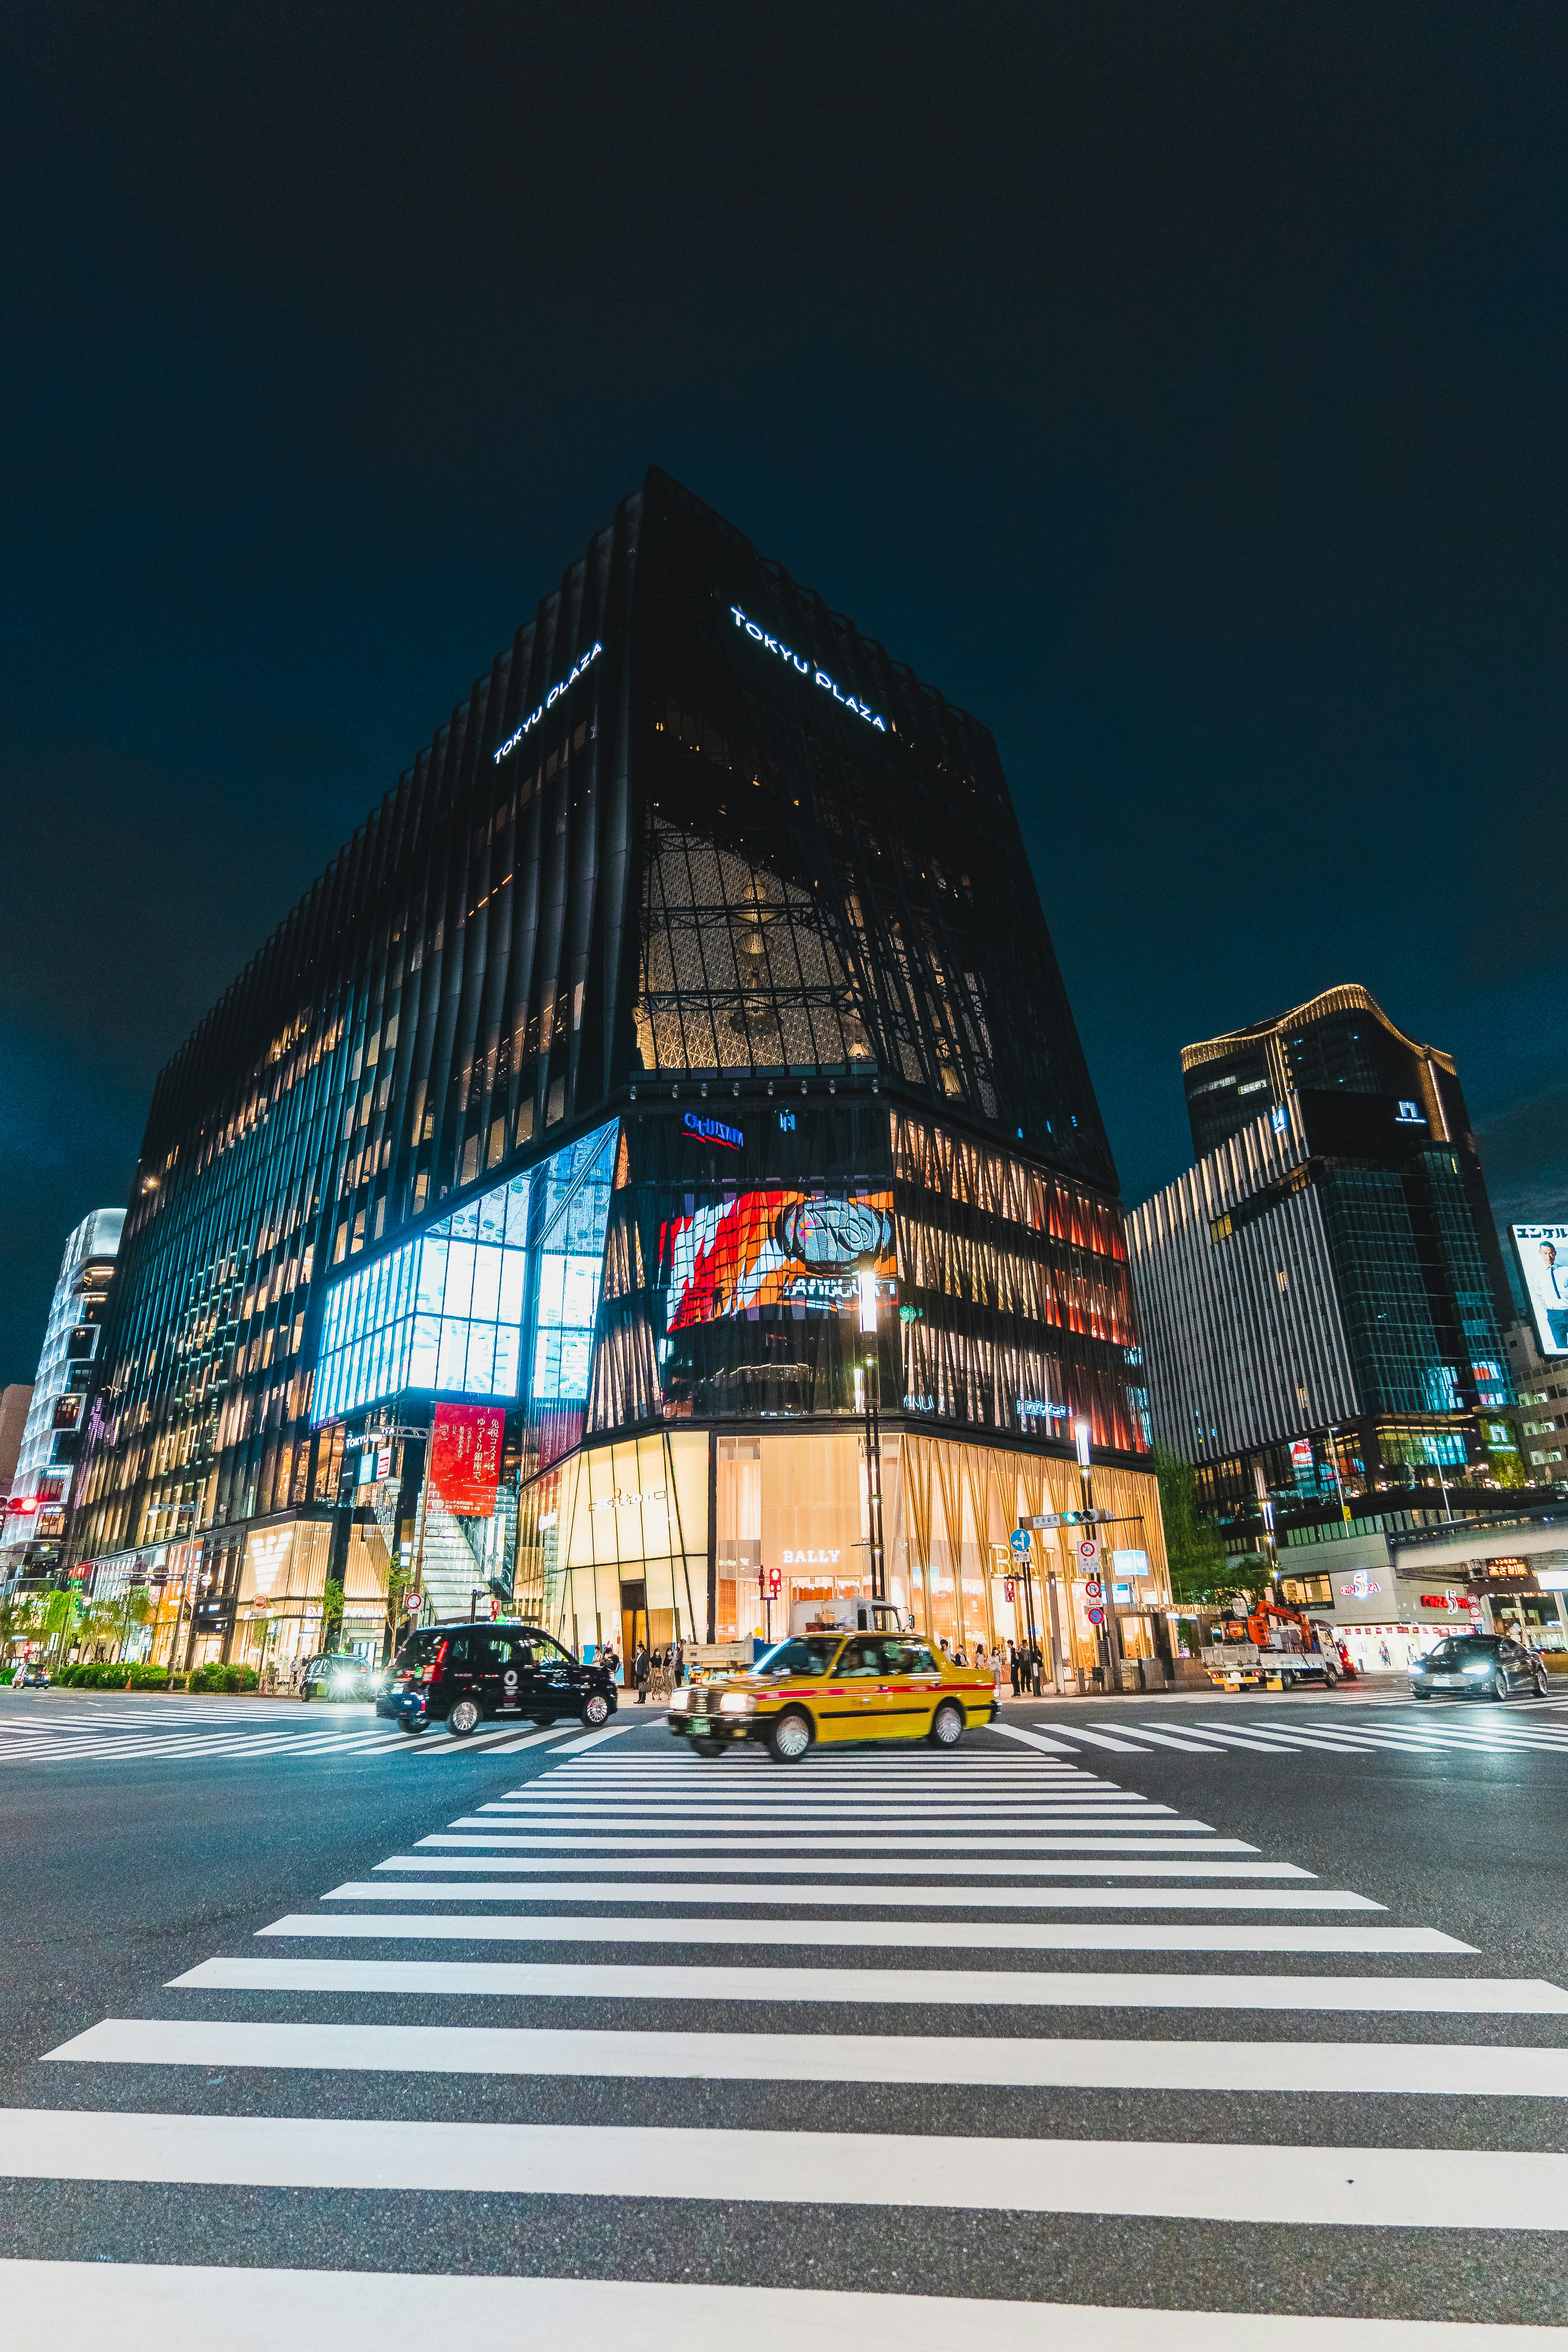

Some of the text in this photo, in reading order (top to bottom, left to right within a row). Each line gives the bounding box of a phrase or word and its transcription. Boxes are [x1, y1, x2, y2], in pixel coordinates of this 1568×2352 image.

[731, 606, 886, 731] TOKYU PLAZA
[494, 642, 602, 764] TOKYU PLAZA
[1516, 1228, 1568, 1238] ユンケル
[346, 1434, 369, 1449] TOKYU
[473, 1418, 486, 1483] ゆっくり銀座で。
[783, 1549, 841, 1564] BALLY
[1489, 1564, 1529, 1576] 高さ制限
